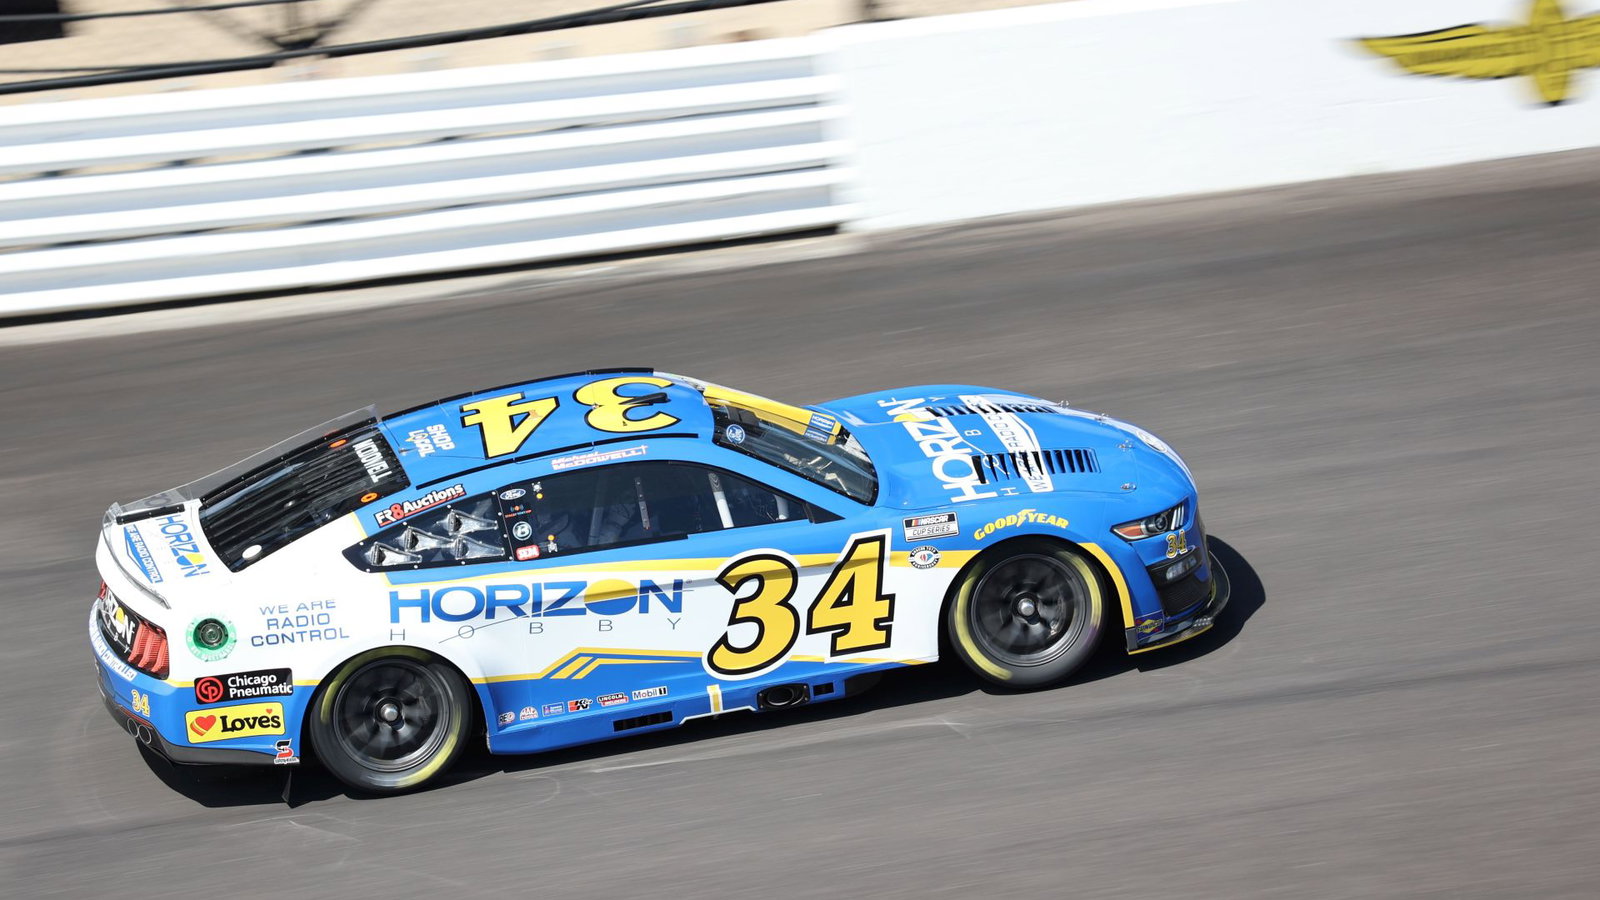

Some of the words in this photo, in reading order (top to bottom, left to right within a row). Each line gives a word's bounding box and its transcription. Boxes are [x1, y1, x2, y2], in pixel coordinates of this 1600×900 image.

[426, 424, 456, 450] SHOP
[920, 514, 949, 526] NASCAR
[973, 509, 1069, 541] GOODYEAR
[912, 528, 927, 536] CUP
[928, 525, 950, 534] SERIES
[155, 515, 210, 578] HORIZON
[1166, 529, 1188, 558] 34
[260, 605, 289, 615] WE
[296, 599, 337, 611] ARE
[389, 579, 684, 624] HORIZON
[704, 531, 897, 679] 34
[266, 613, 330, 630] RADIO
[389, 617, 681, 641] HOBBY
[251, 627, 350, 647] CONTROL
[227, 674, 277, 688] Chicago
[229, 683, 293, 698] Pneumatic
[131, 689, 150, 717] 34
[598, 693, 624, 702] LINCOLN
[633, 689, 658, 699] Mobil
